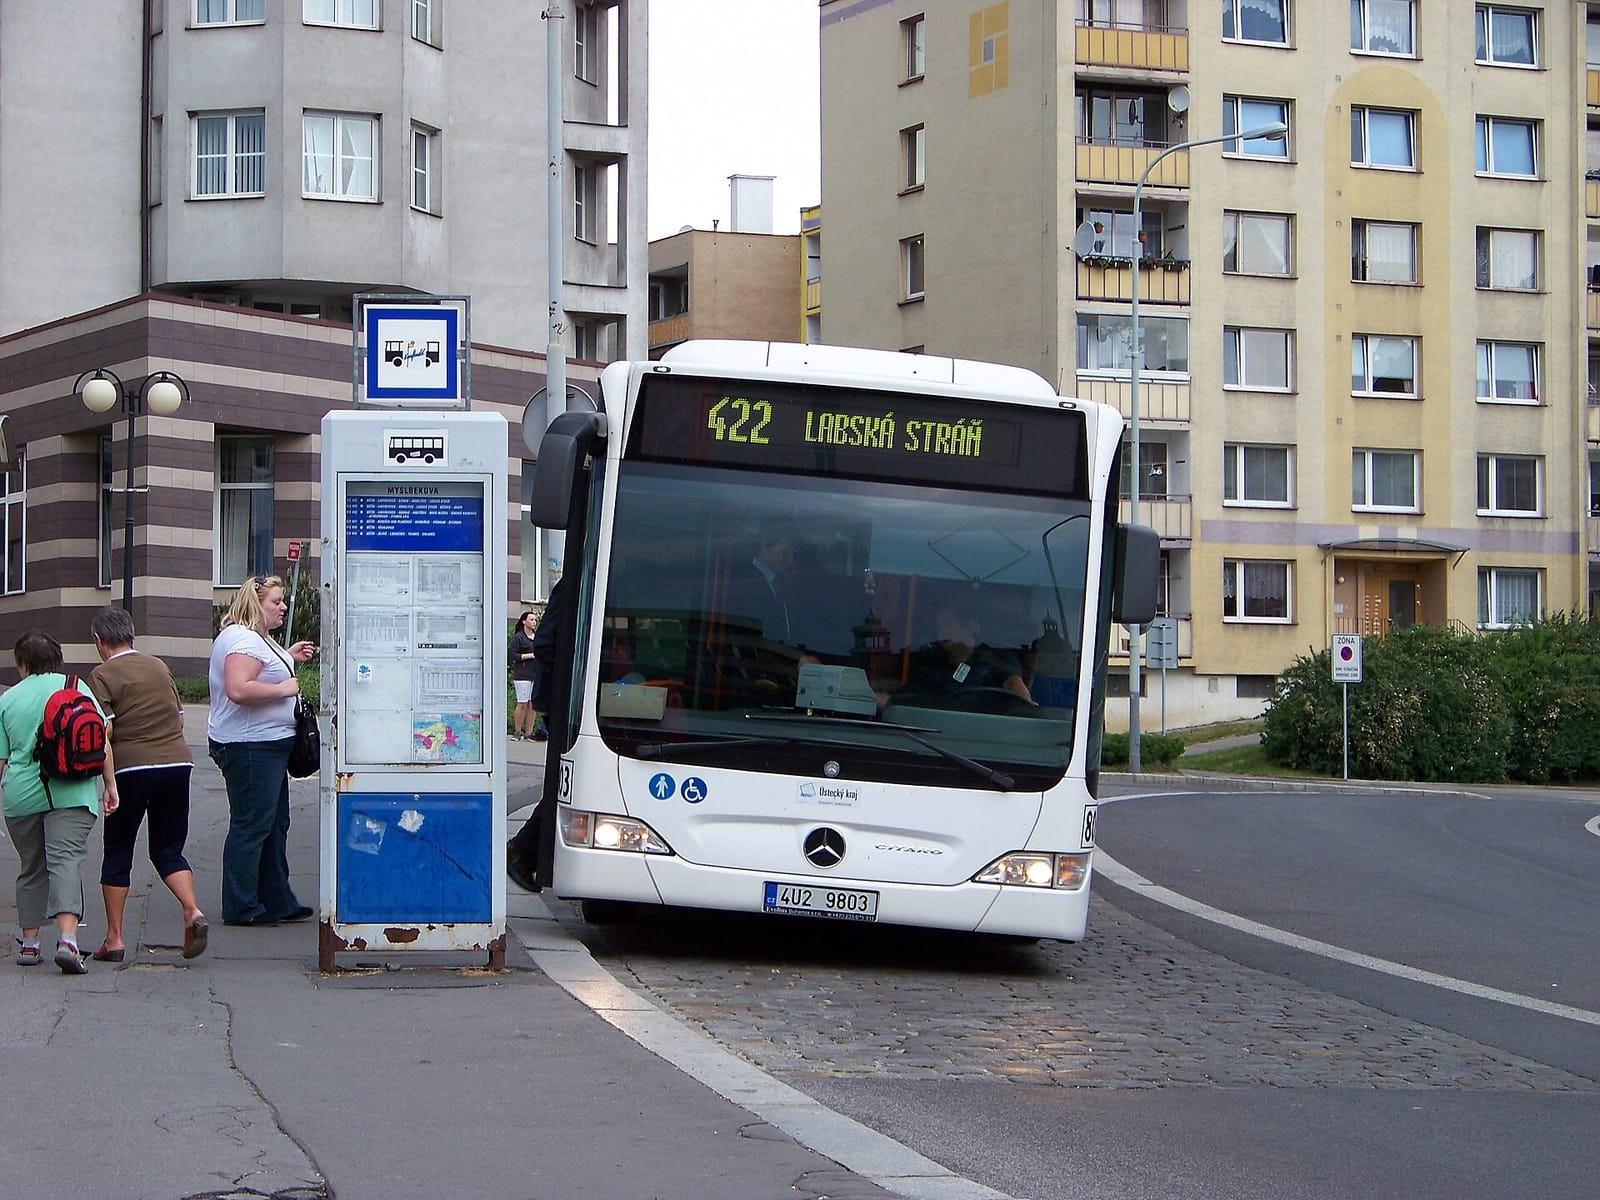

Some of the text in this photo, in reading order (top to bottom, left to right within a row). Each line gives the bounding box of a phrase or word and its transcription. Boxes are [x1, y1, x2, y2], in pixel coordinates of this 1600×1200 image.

[707, 396, 984, 457] 422 LABSKÁ STRÁŇ
[387, 486, 439, 495] MYSLBEKOVA
[819, 785, 844, 800] Ústecký
[845, 789, 858, 801] kraj
[875, 843, 944, 856] CITARO
[766, 896, 776, 904] CZ
[780, 887, 868, 911] 4U2 9803
